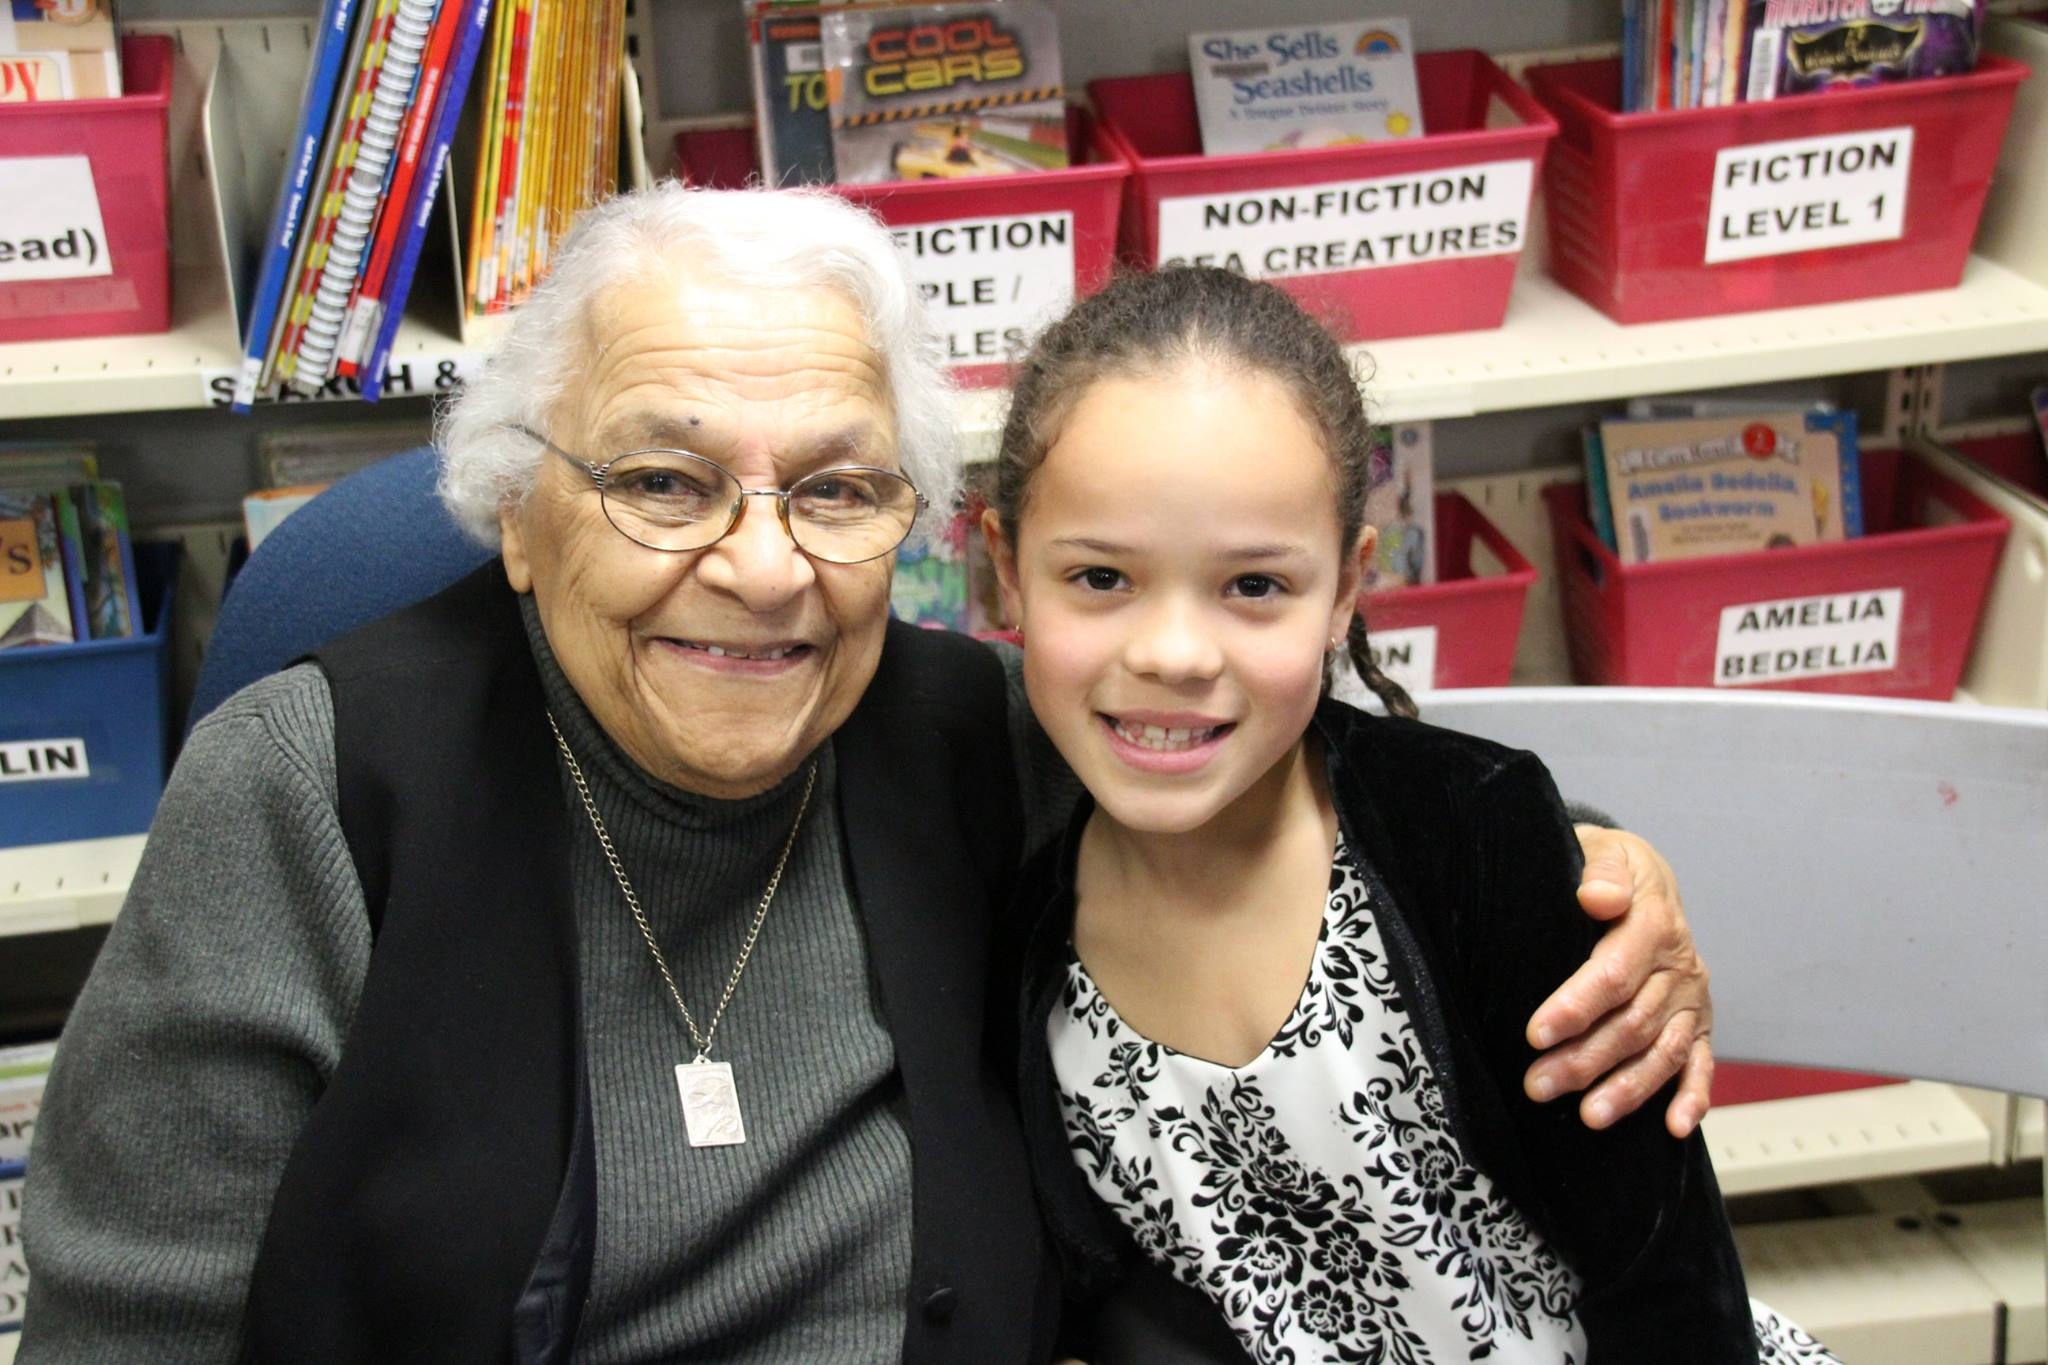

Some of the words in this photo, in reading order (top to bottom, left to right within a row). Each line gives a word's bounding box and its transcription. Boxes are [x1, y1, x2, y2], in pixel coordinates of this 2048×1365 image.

[867, 16, 1016, 63] COOL
[1266, 30, 1341, 67] Sells
[1232, 64, 1374, 105] Seashells
[1726, 141, 1897, 188] FICTION
[1204, 173, 1486, 228] NON-FICTION
[1721, 201, 1849, 240] LEVEL
[1868, 194, 1885, 221] 1
[1264, 220, 1519, 272] CREATURES
[434, 360, 462, 390] &
[1736, 595, 1885, 633] AMELIA
[1722, 641, 1888, 678] BEDELIA
[0, 745, 78, 776] LIN
